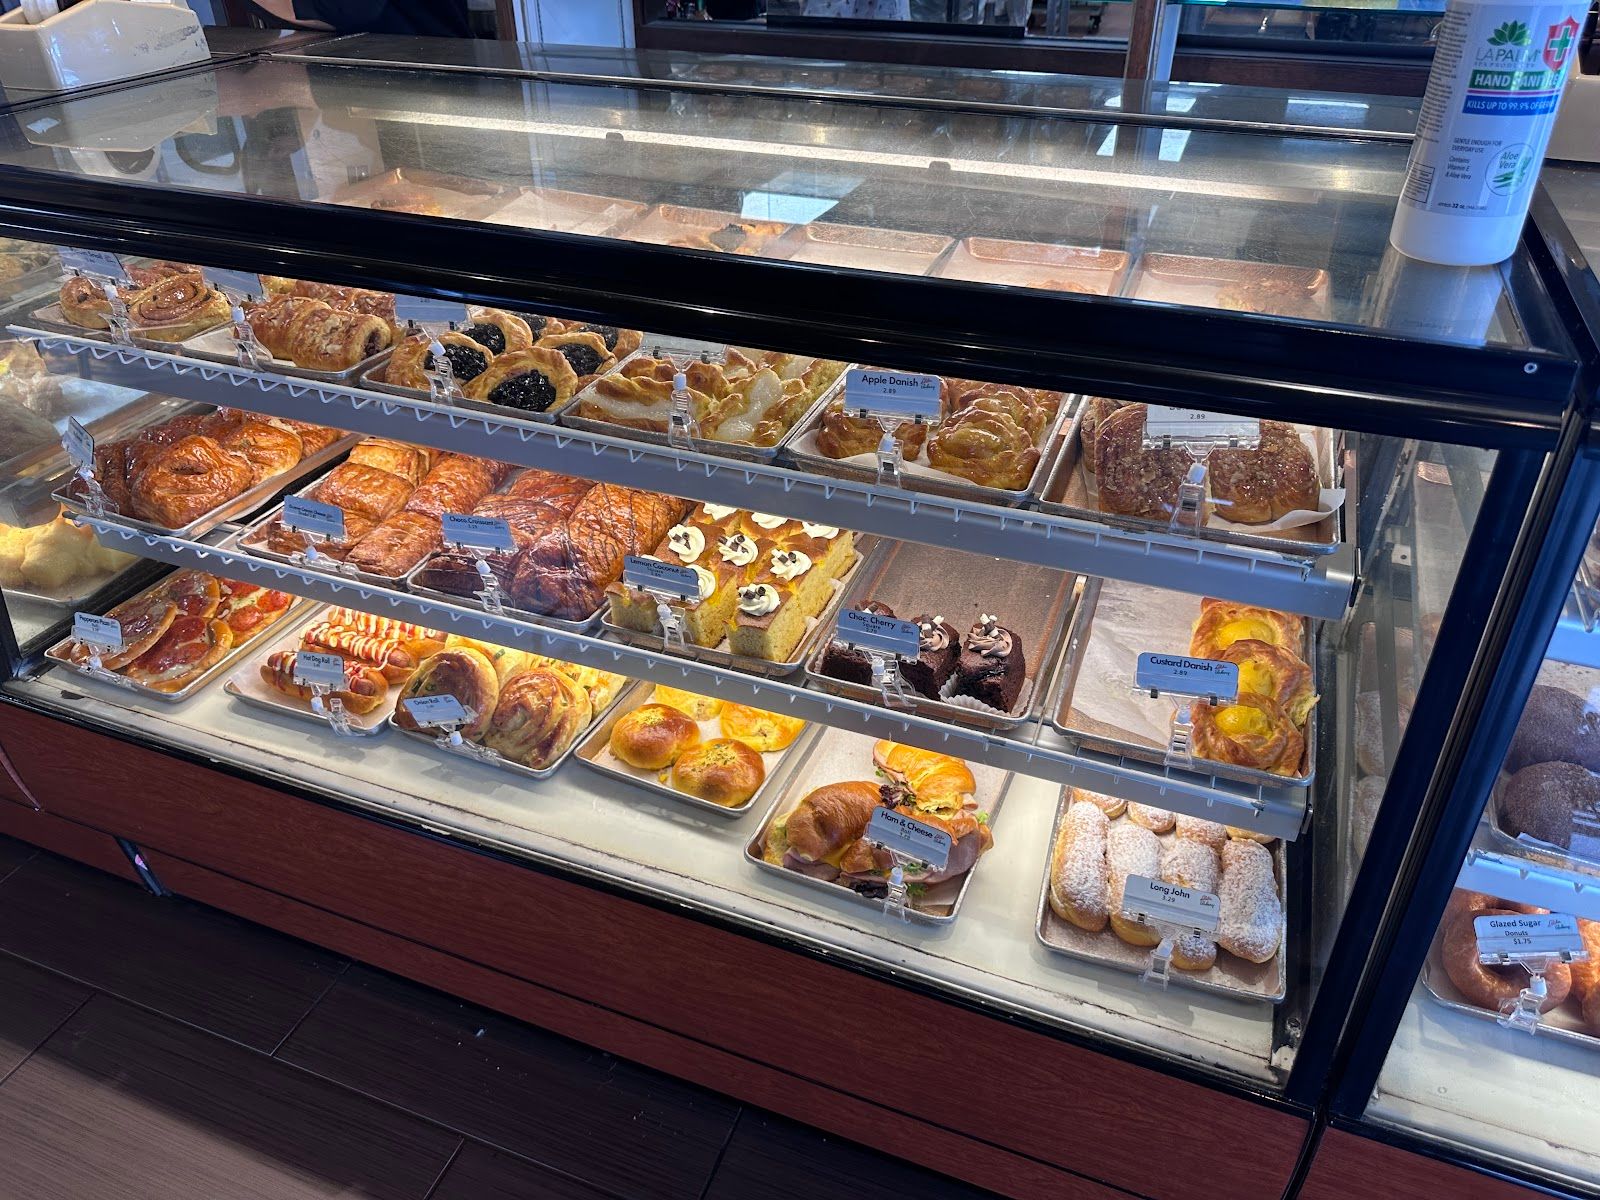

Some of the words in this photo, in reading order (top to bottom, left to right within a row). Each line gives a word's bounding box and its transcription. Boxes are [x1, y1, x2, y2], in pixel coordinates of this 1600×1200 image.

[1474, 73, 1511, 87] HAND
[1466, 101, 1486, 110] KILLS
[1486, 101, 1498, 109] UP
[1498, 101, 1507, 110] TO
[1508, 102, 1530, 110] 99.9%
[1501, 151, 1519, 160] Aloe
[1499, 160, 1517, 169] Vera
[862, 374, 887, 385] Apple
[889, 377, 919, 387] Danish
[630, 557, 652, 568] Lemon
[652, 562, 680, 574] Coconut
[848, 612, 870, 623] Choc.
[870, 616, 897, 630] Cherry
[312, 655, 321, 664] Dog
[1150, 656, 1183, 668] Custard
[1183, 660, 1213, 671] Danish
[880, 810, 899, 824] Ham
[900, 818, 906, 828] &
[907, 821, 934, 839] Cheese
[1150, 881, 1171, 895] Long
[1171, 886, 1191, 899] John
[1162, 894, 1176, 903] 3.29
[1489, 919, 1517, 929] Glazed
[1518, 918, 1541, 930] Sugar
[1513, 937, 1532, 946] $1.75
